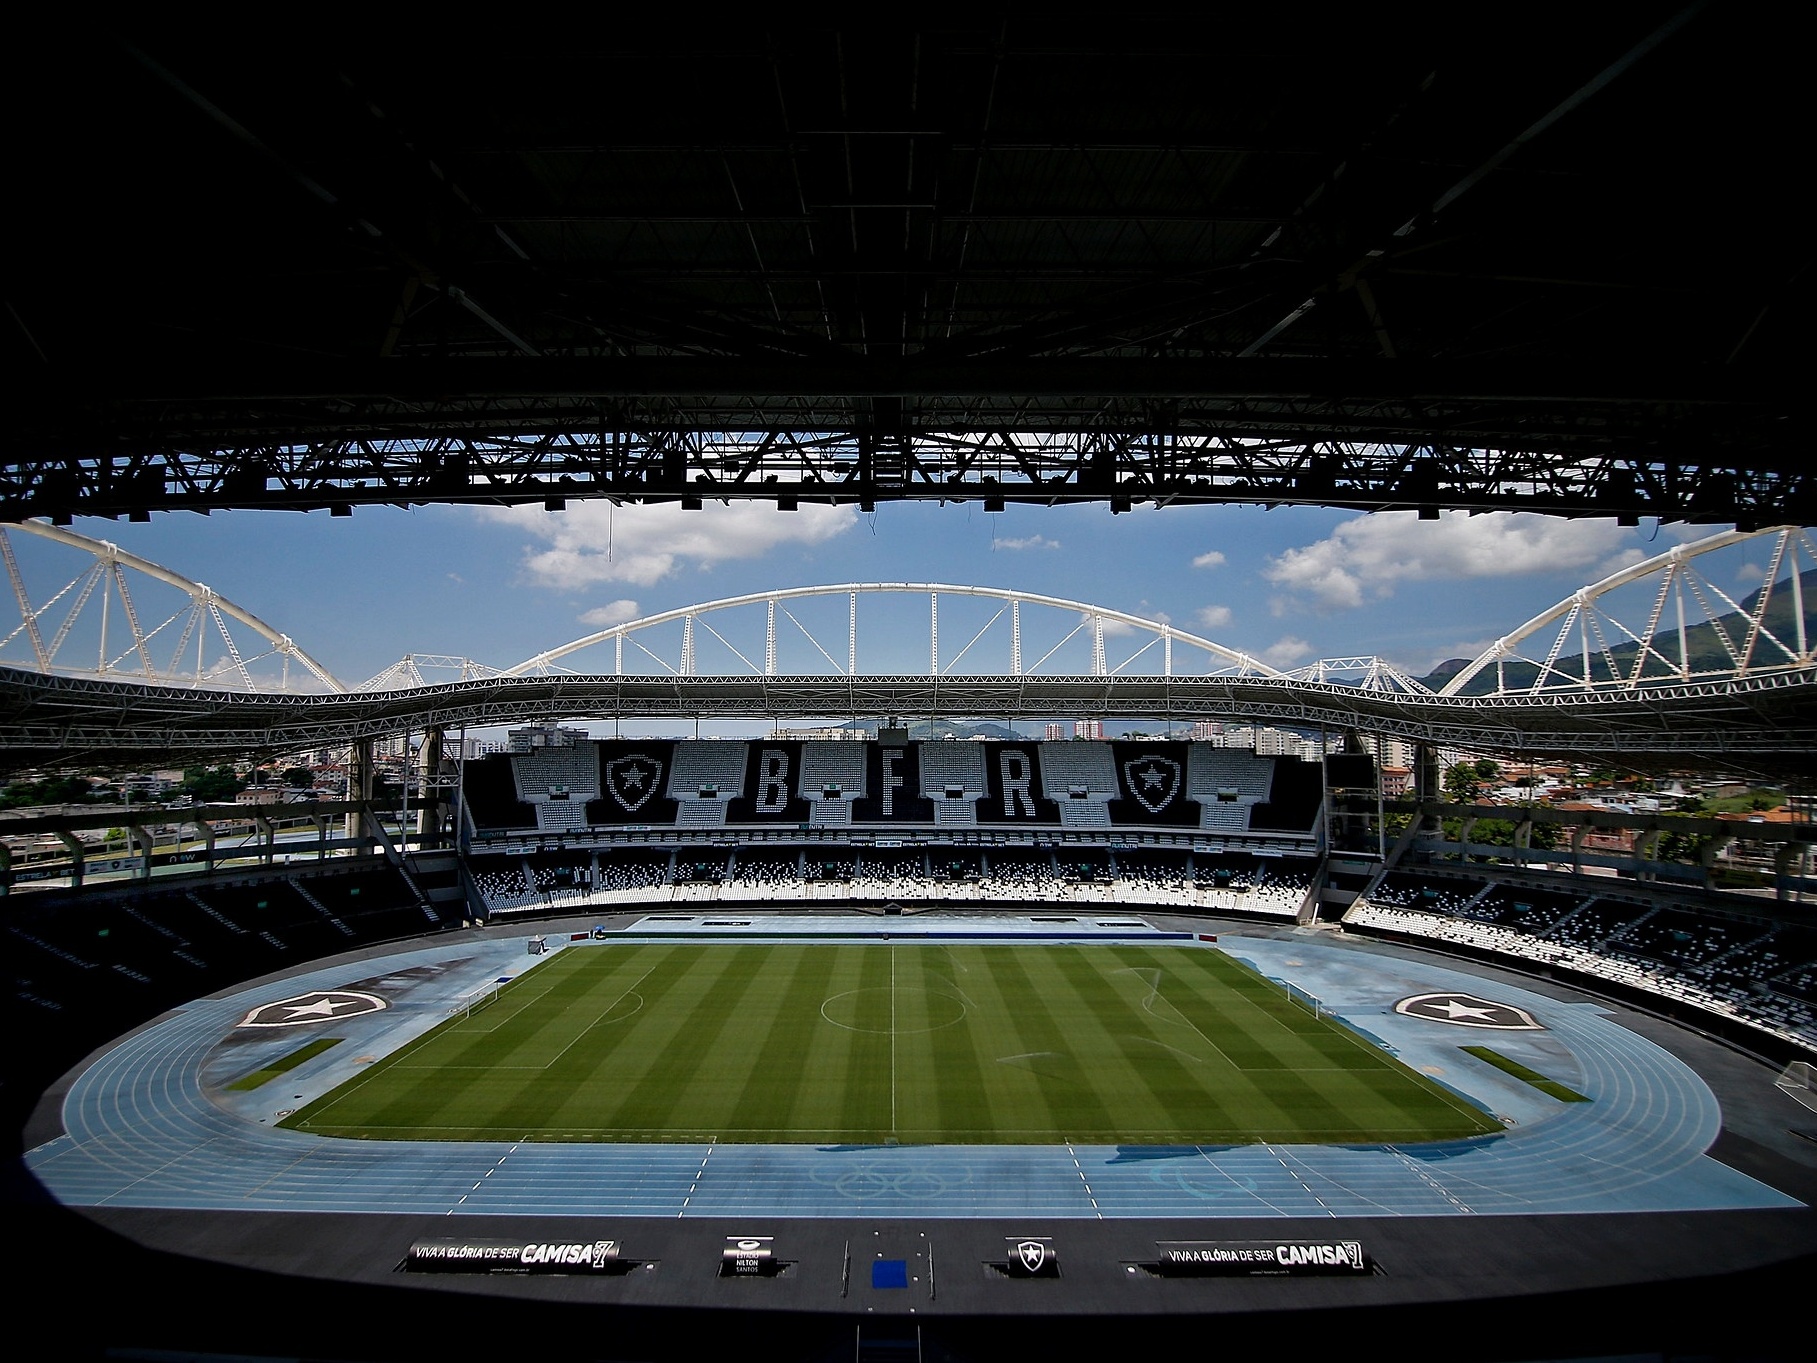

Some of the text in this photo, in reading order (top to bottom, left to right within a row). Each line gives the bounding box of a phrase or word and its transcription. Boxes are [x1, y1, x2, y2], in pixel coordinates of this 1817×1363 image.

[416, 1246, 437, 1259] VIVA
[446, 1245, 483, 1259] GLÓRIA
[483, 1247, 500, 1259] DE
[500, 1246, 520, 1259] SER
[1168, 1250, 1193, 1262] VIVA
[1202, 1248, 1239, 1262] GLÓRIA
[1239, 1250, 1253, 1262] DE
[1253, 1250, 1275, 1262] SER
